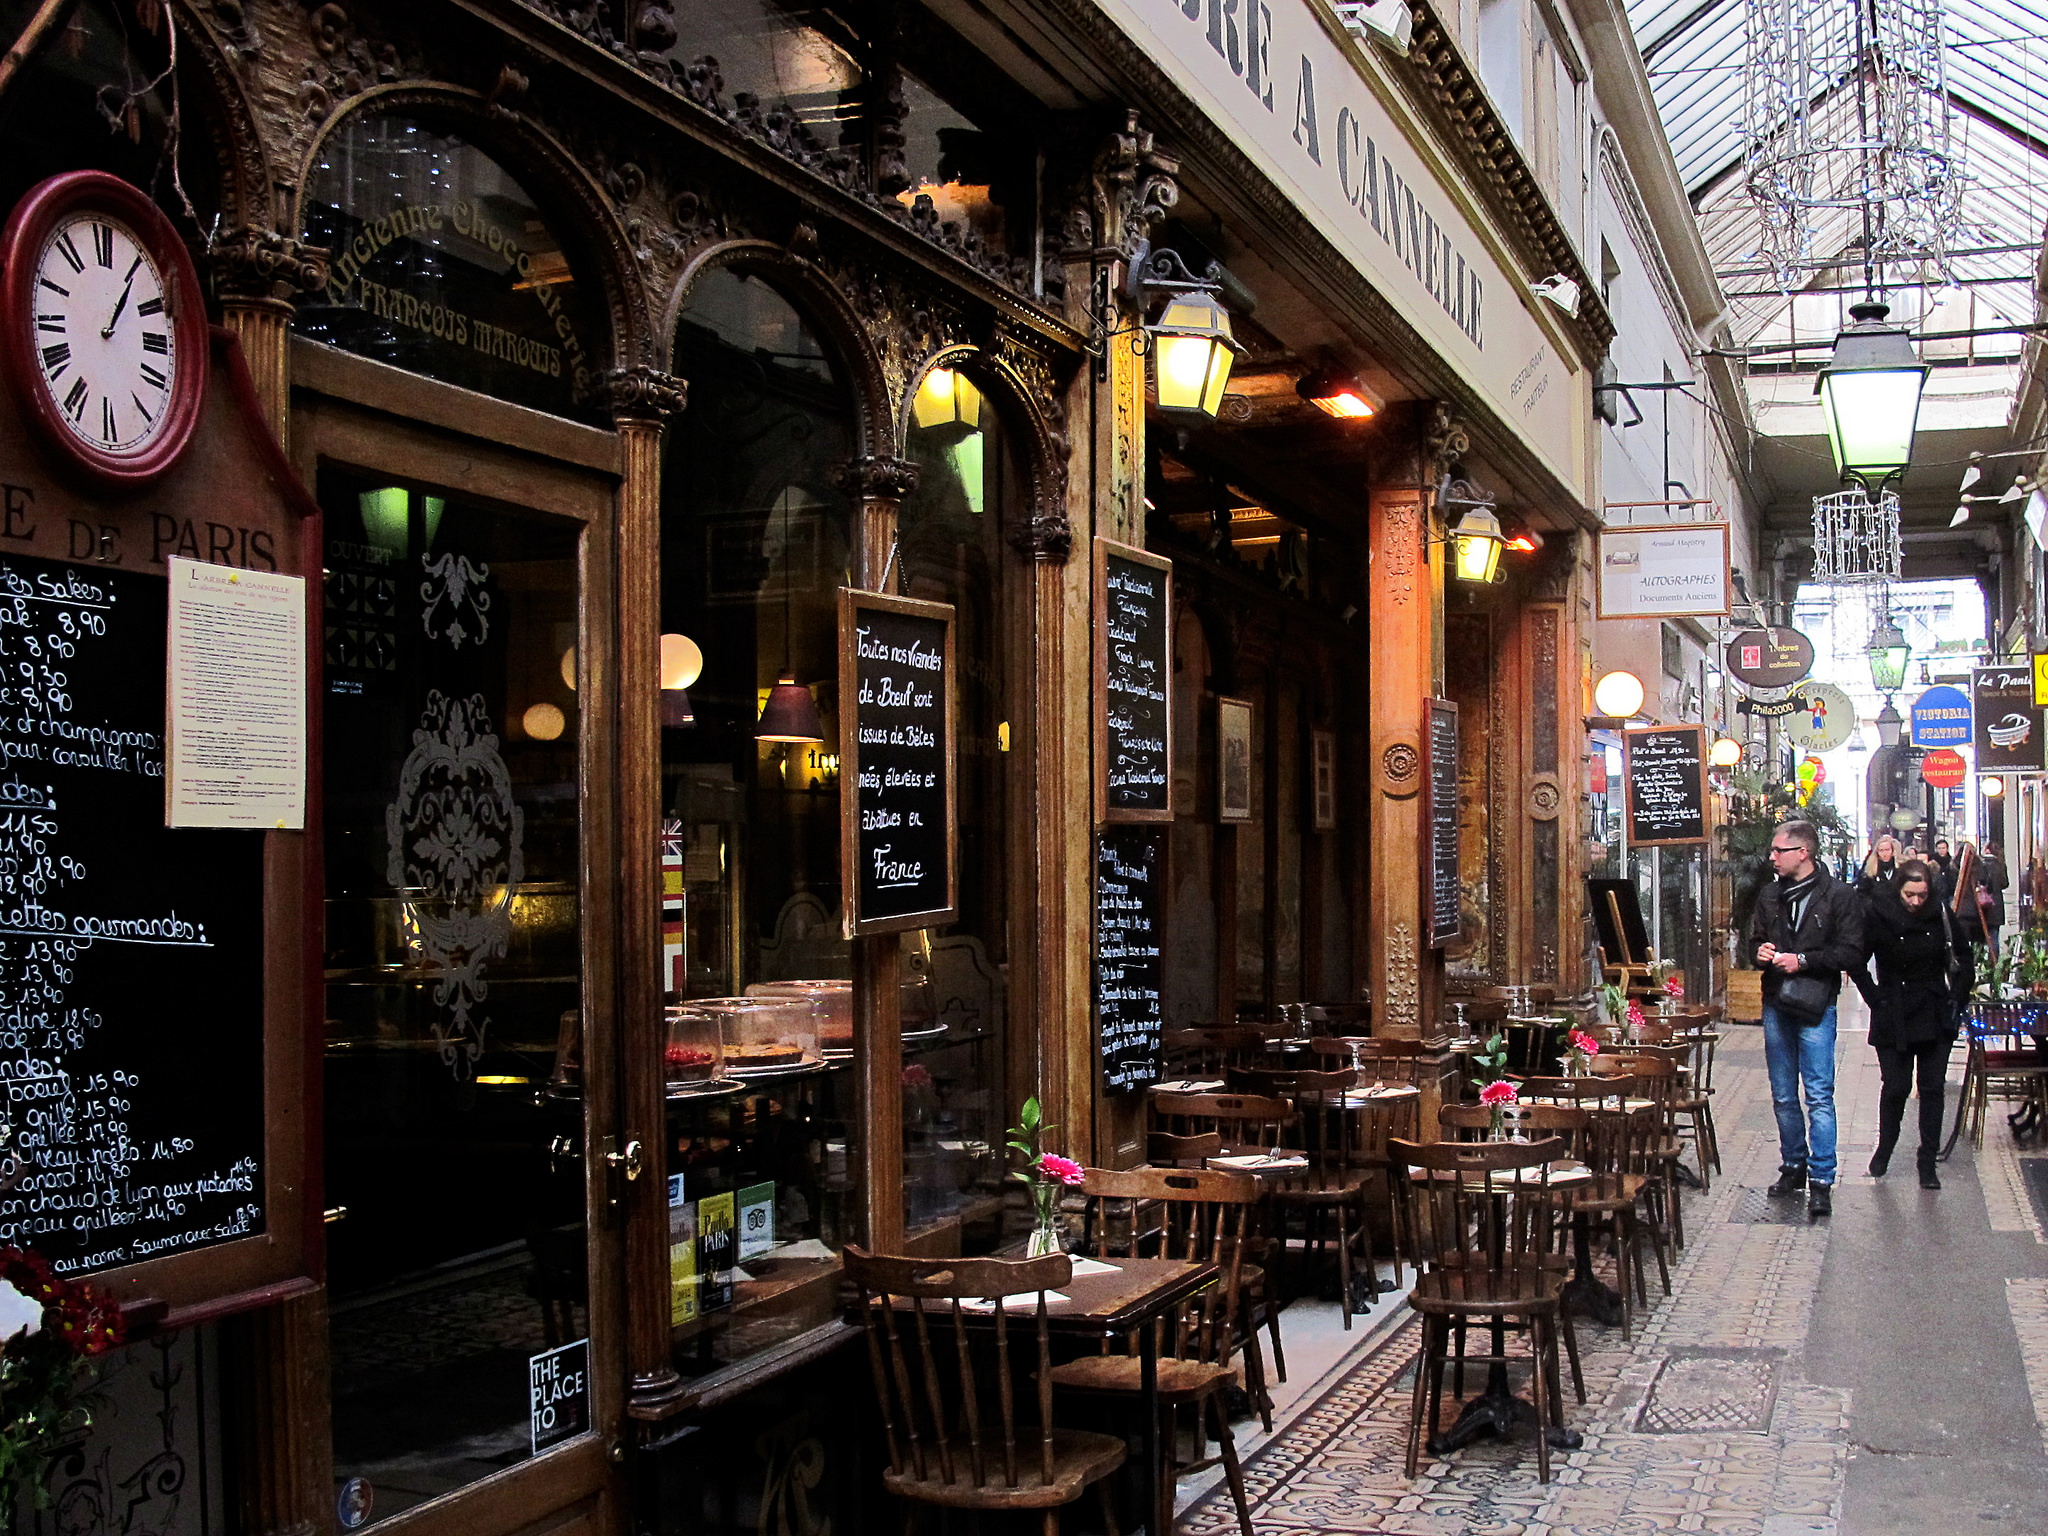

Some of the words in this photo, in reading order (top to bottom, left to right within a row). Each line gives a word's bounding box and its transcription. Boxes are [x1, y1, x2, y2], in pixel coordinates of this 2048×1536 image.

[1181, 0, 1274, 114] RE
[1293, 54, 1322, 167] A
[1337, 107, 1484, 352] CANNELLE
[323, 204, 443, 308] Ancienne
[1510, 343, 1546, 400] RESTAURANT
[1523, 374, 1548, 418] TRAITEUR
[67, 518, 123, 566] DE
[150, 510, 279, 575] PARIS
[329, 539, 393, 567] OUVERT
[1640, 574, 1717, 587] AUTOGRAPHES
[1639, 593, 1683, 603] Documents
[1685, 591, 1718, 601] Anciens
[58, 611, 106, 640] 8,90
[24, 634, 75, 663] 8,90
[856, 626, 889, 660] Toutes
[891, 646, 908, 664] nos
[908, 639, 942, 671] Viandes
[20, 662, 67, 692] 9,30
[1769, 661, 1801, 669] collection
[859, 678, 874, 704] de
[914, 690, 933, 707] sont
[1976, 673, 1993, 688] Le
[21, 687, 73, 713] 8,90
[1751, 702, 1794, 716] Phila2000
[1915, 707, 1971, 721] VICTORIA
[859, 722, 888, 745] issues
[890, 725, 905, 744] de
[906, 725, 934, 748] Bêtes
[1800, 735, 1839, 750] Glacier
[1919, 727, 1967, 740] STATION
[53, 745, 132, 773] consulter
[1929, 756, 1959, 766] Wagon
[924, 772, 936, 788] et
[1922, 768, 1966, 777] restaurant
[909, 811, 924, 827] en
[72, 909, 207, 949] gourmandes:
[25, 939, 77, 965] 13,90
[20, 963, 74, 987] 13,90
[20, 984, 64, 1009] 13,90
[83, 1070, 139, 1094] 15,90
[83, 1096, 130, 1119] 15,90
[86, 1120, 128, 1145] 17,90
[151, 1136, 194, 1161] 14,80
[86, 1162, 130, 1185] 14,80
[29, 1180, 98, 1213] chaud
[163, 1182, 194, 1198] aux
[145, 1199, 186, 1222] 14,90
[54, 1258, 82, 1273] au
[132, 1233, 185, 1255] Saumon
[214, 1215, 251, 1237] Salade
[532, 1356, 561, 1386] THE
[532, 1370, 583, 1410] PLACE
[533, 1406, 556, 1433] TO
